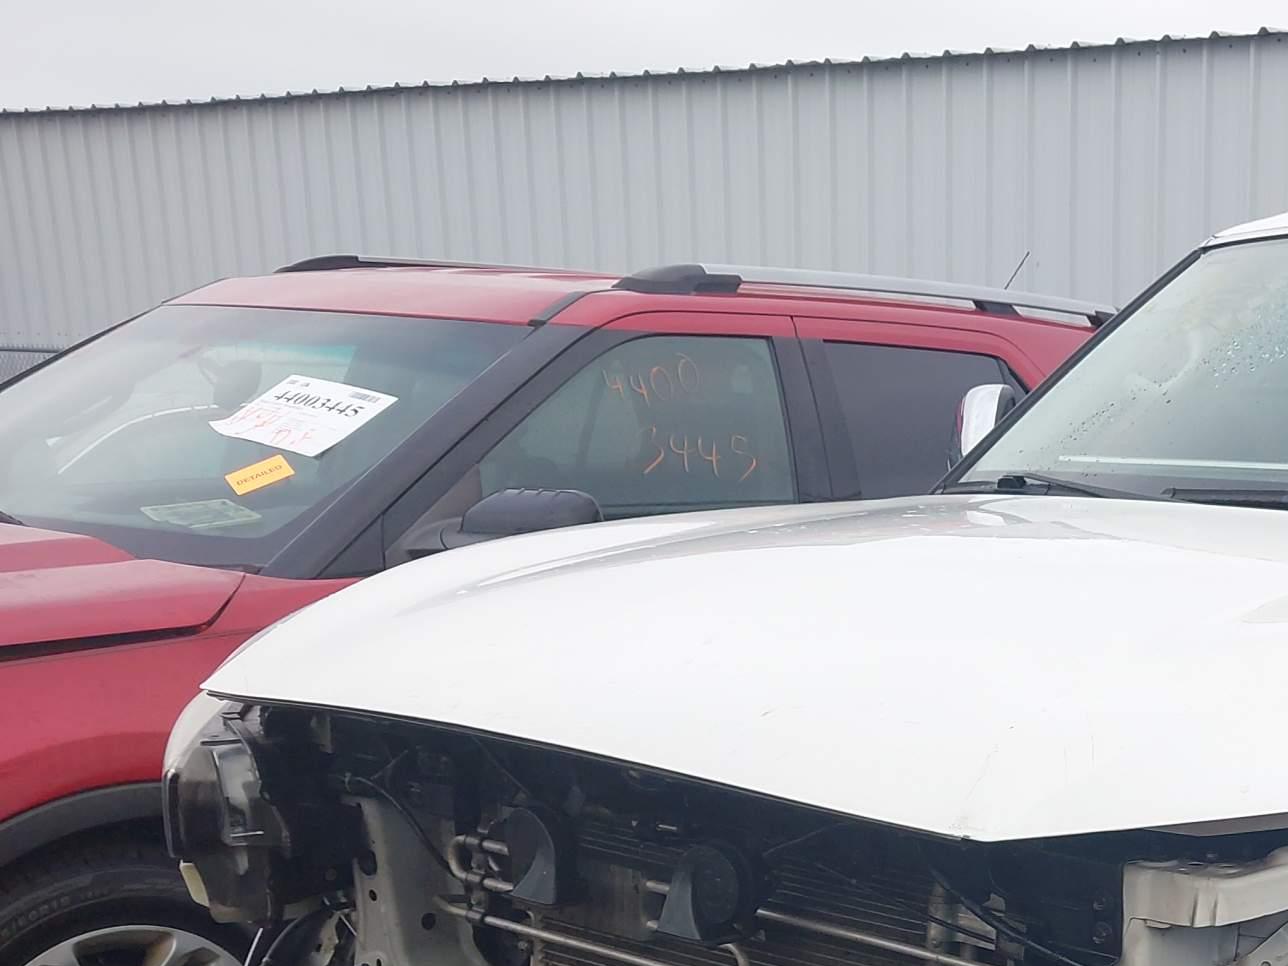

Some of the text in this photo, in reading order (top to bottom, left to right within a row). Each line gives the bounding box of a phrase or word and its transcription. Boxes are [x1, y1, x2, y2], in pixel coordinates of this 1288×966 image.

[601, 352, 700, 407] 4400
[273, 390, 365, 417] 44003445
[235, 464, 283, 486] DETAILED
